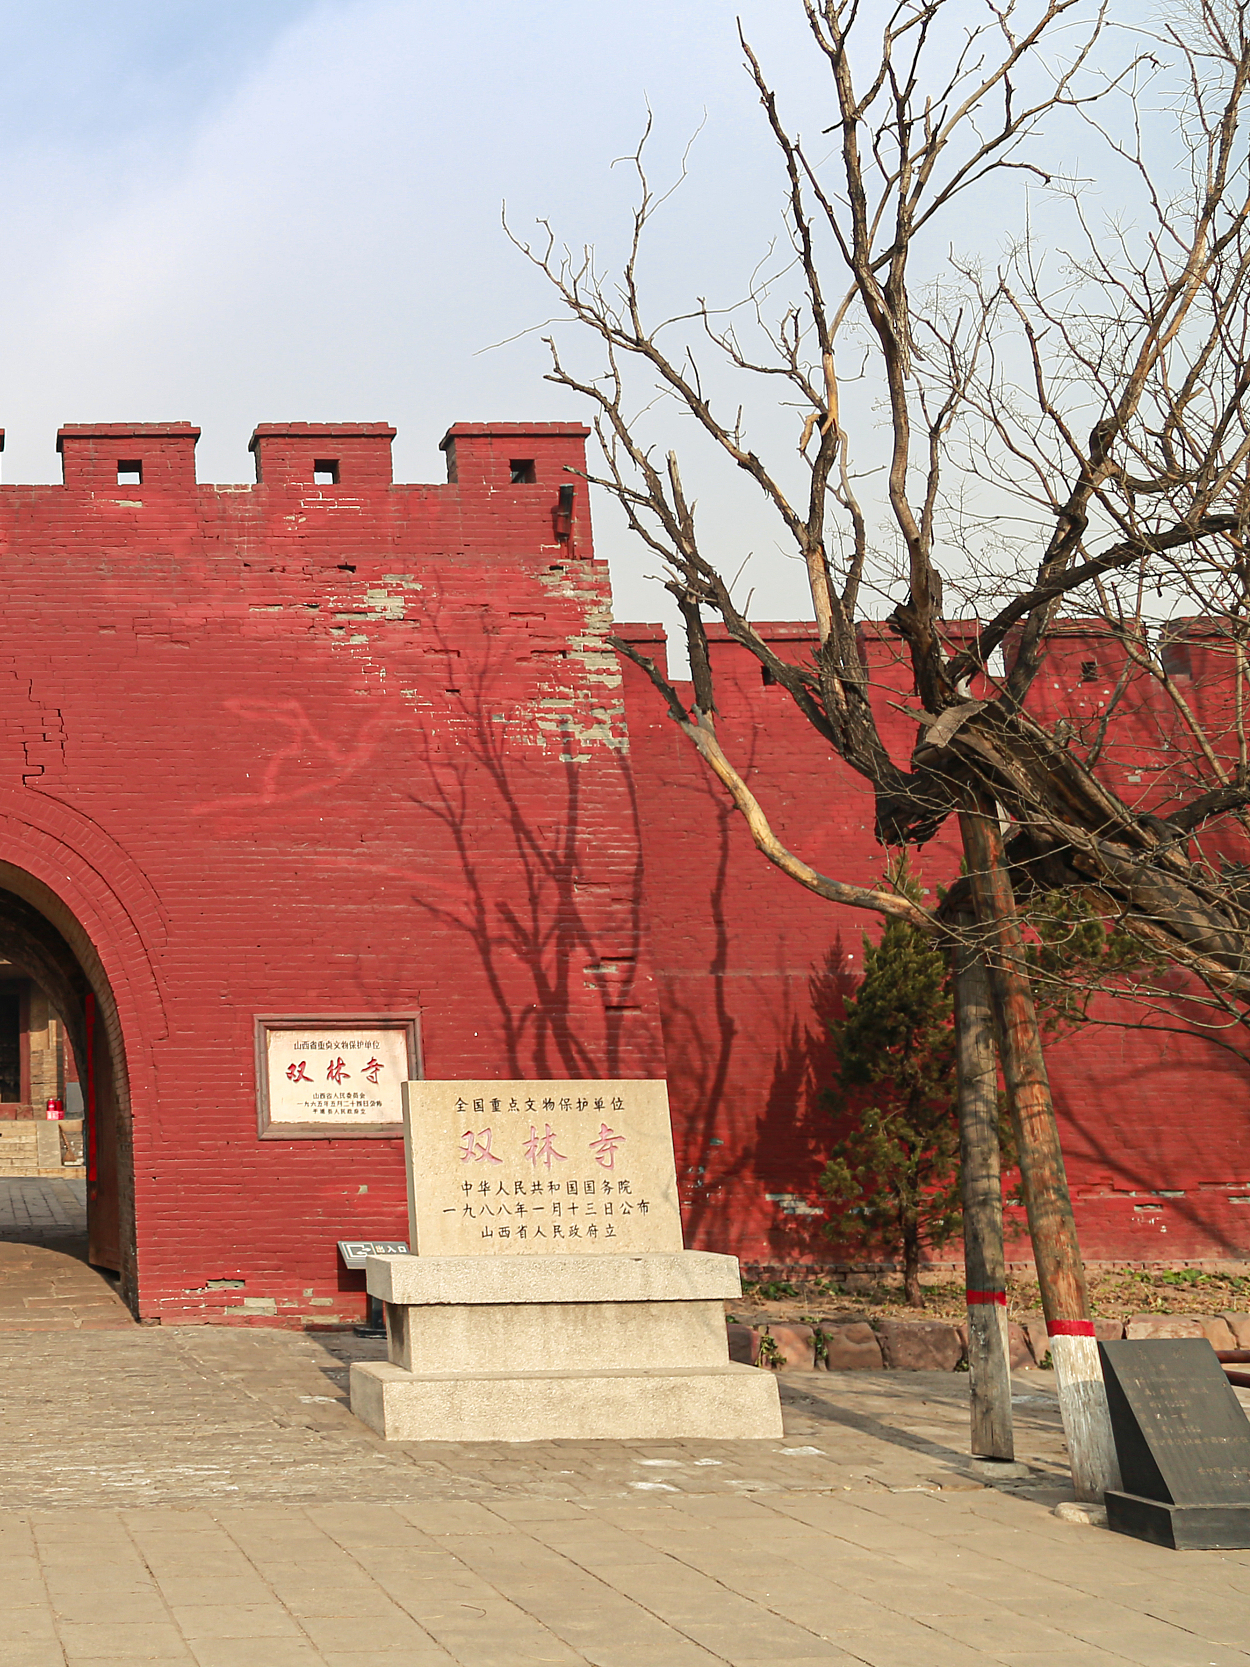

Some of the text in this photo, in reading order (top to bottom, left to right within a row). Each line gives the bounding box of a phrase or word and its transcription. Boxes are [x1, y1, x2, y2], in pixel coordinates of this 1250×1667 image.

[294, 1040, 380, 1050] 山西省重点文物保护单位
[285, 1056, 384, 1085] 双林寺
[455, 1097, 626, 1113] 全国重点文物保护单位
[458, 1122, 627, 1171] 双林寺
[460, 1180, 633, 1197] 中华人民共和国国务院
[442, 1199, 651, 1219] 一九八八年一月十三日公布
[481, 1225, 618, 1239] 山西省人民政府立
[375, 1245, 407, 1253] 出入口
